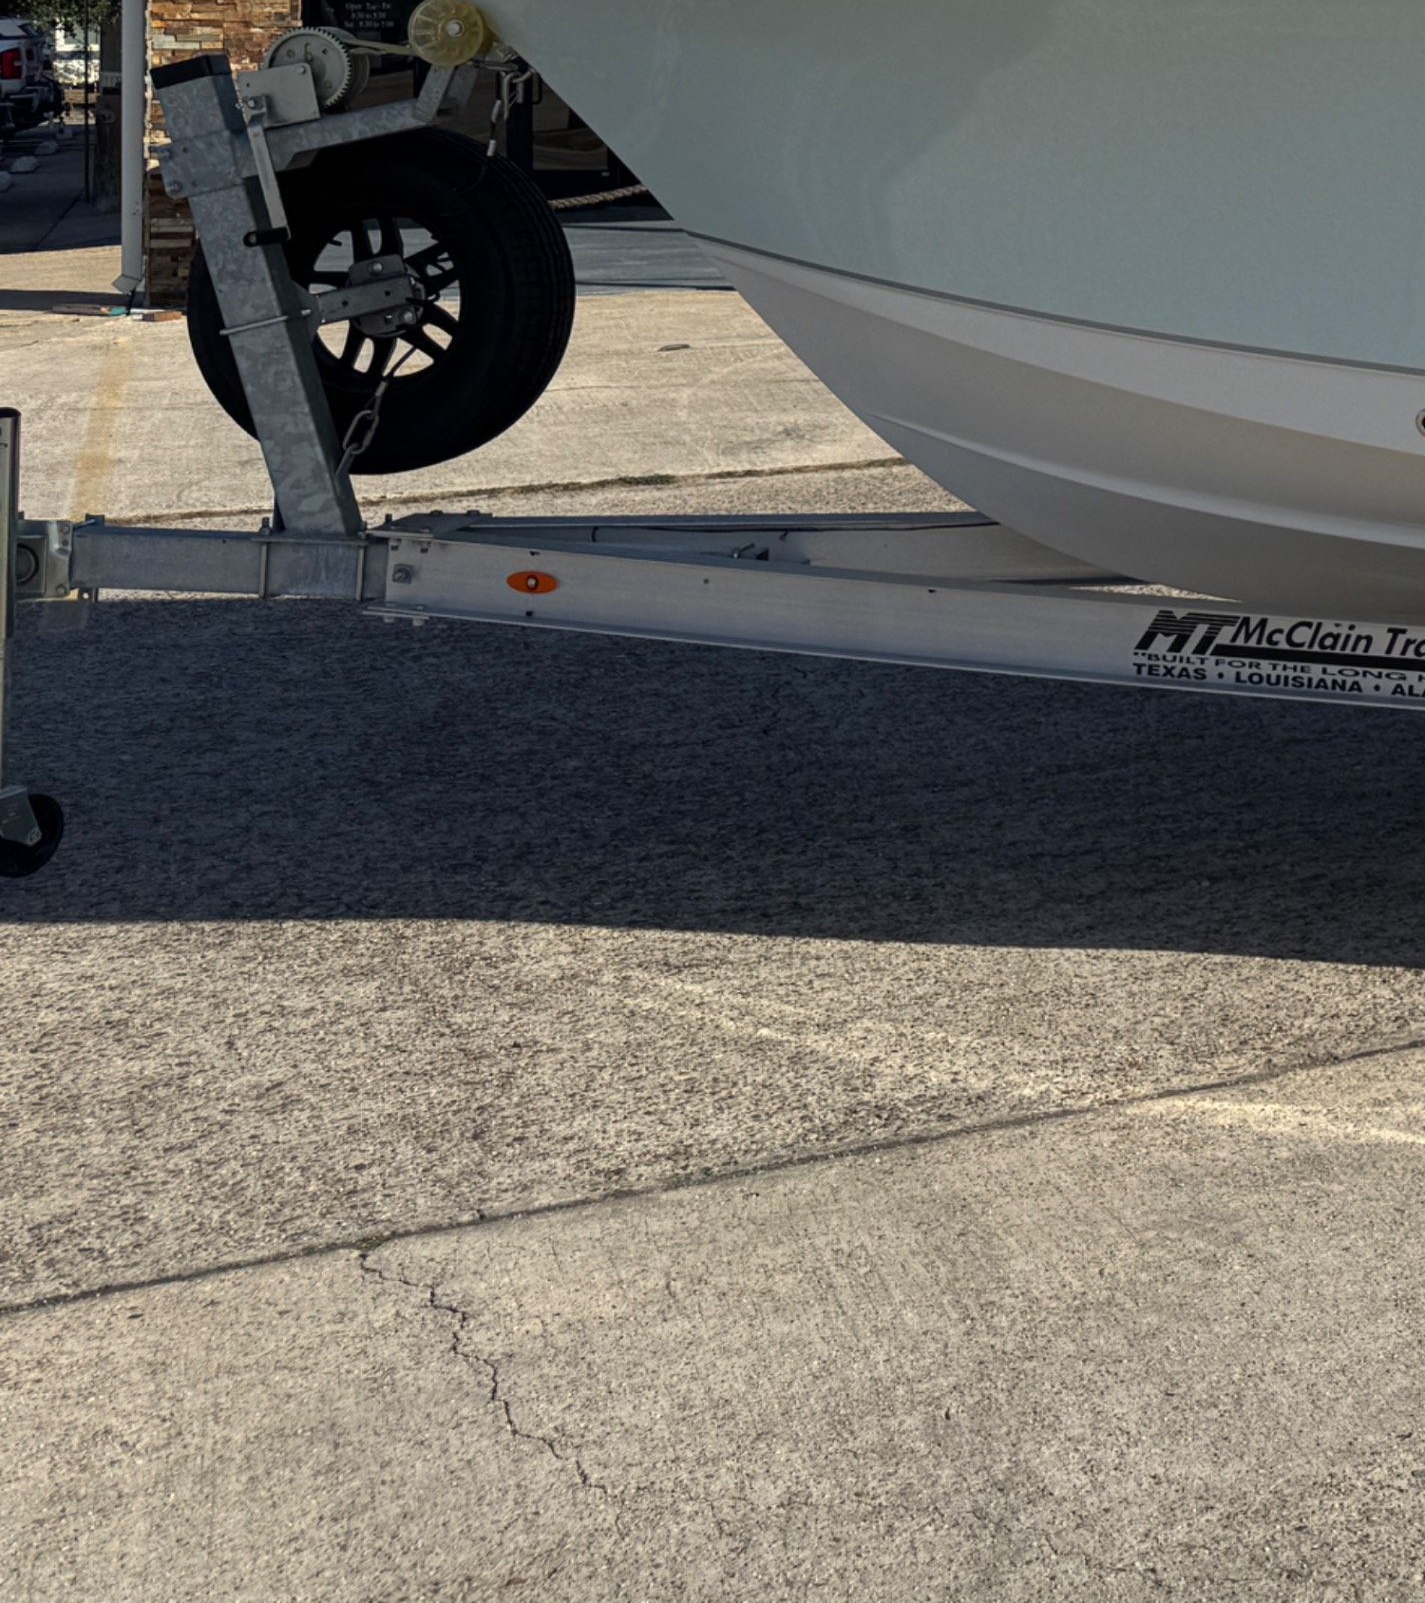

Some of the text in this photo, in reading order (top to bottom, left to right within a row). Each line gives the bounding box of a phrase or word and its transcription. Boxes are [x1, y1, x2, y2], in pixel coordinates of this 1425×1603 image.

[1230, 615, 1374, 654] McClain
[1132, 662, 1208, 681] TEXAS
[1234, 670, 1364, 694] LOUISIANA
[1214, 658, 1262, 671] FOR
[1268, 662, 1313, 675] THE
[1321, 666, 1408, 681] LONG
